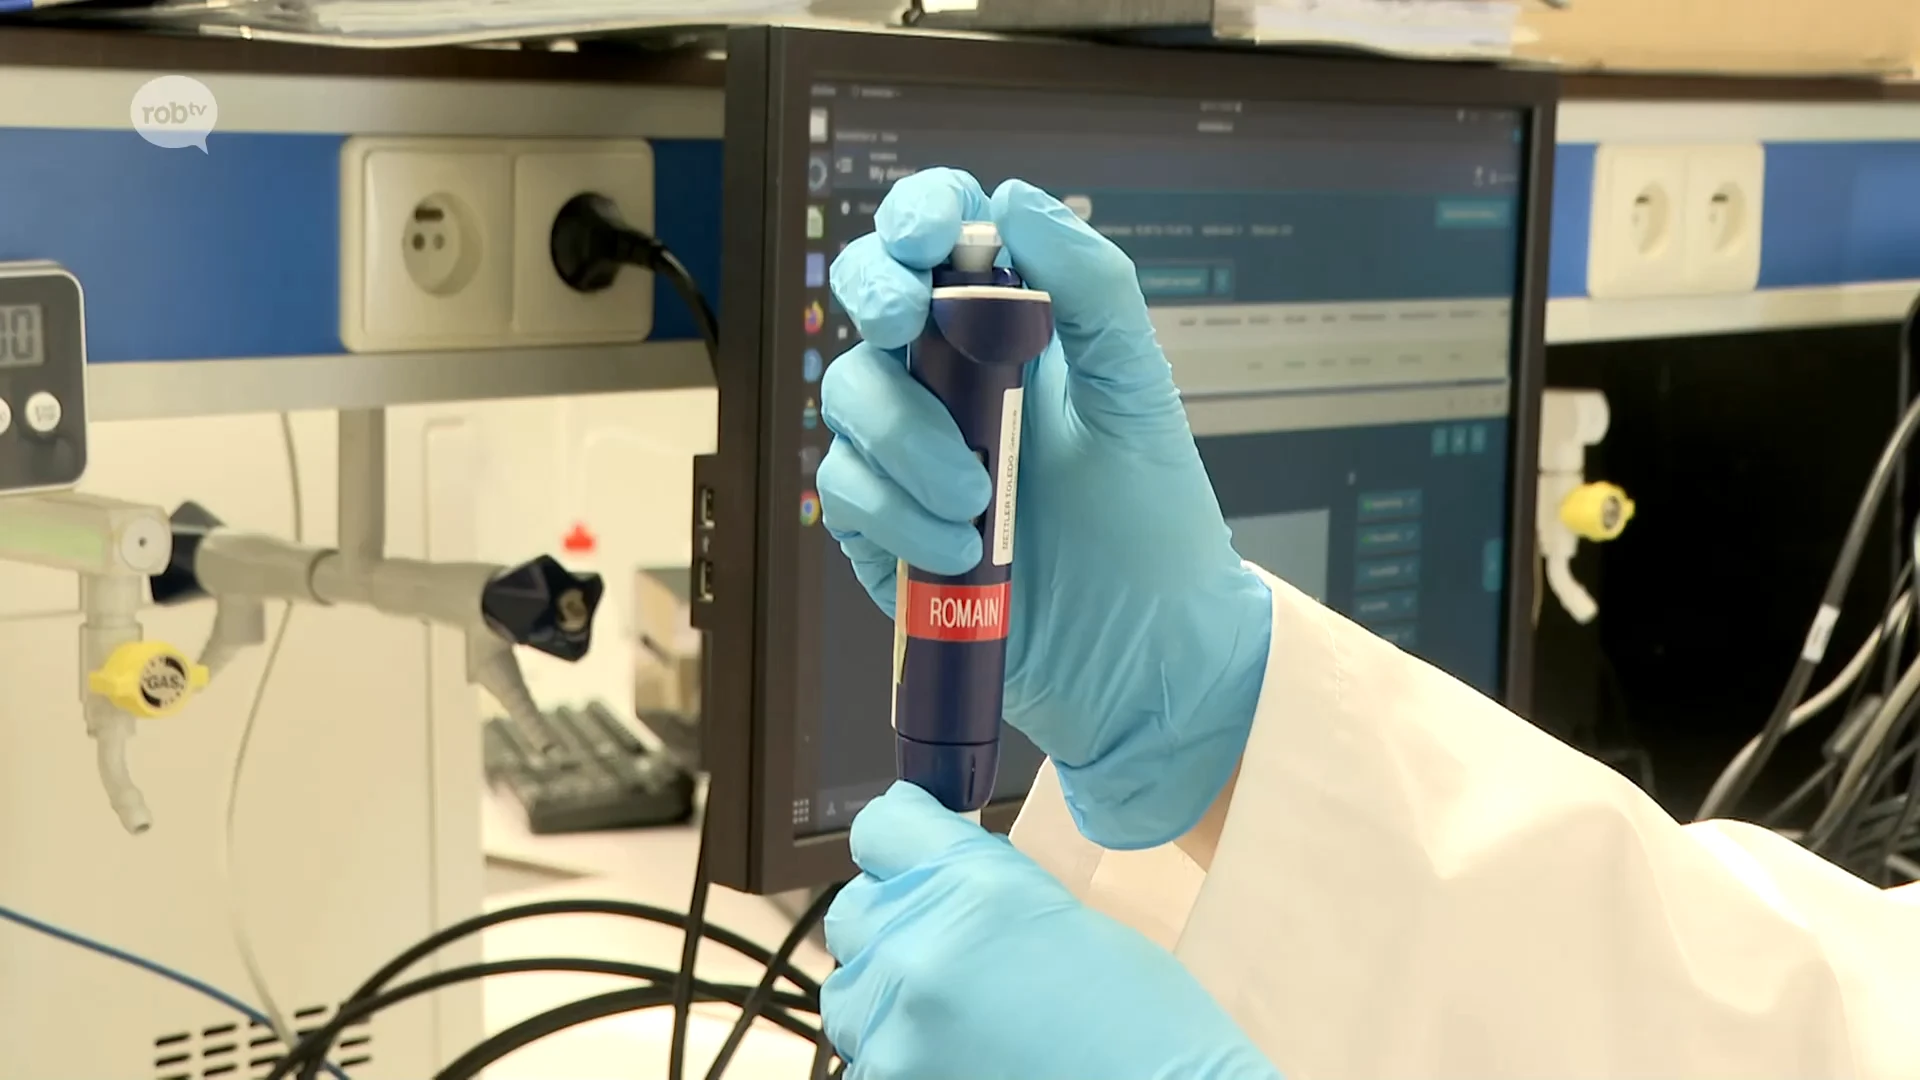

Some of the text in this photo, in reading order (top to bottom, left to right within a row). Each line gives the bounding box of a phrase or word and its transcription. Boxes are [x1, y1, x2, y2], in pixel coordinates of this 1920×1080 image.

[1005, 455, 1014, 499] TOLEDO
[1002, 501, 1011, 550] METTLER
[929, 597, 1000, 629] ROMAIN
[147, 675, 179, 690] GAS
